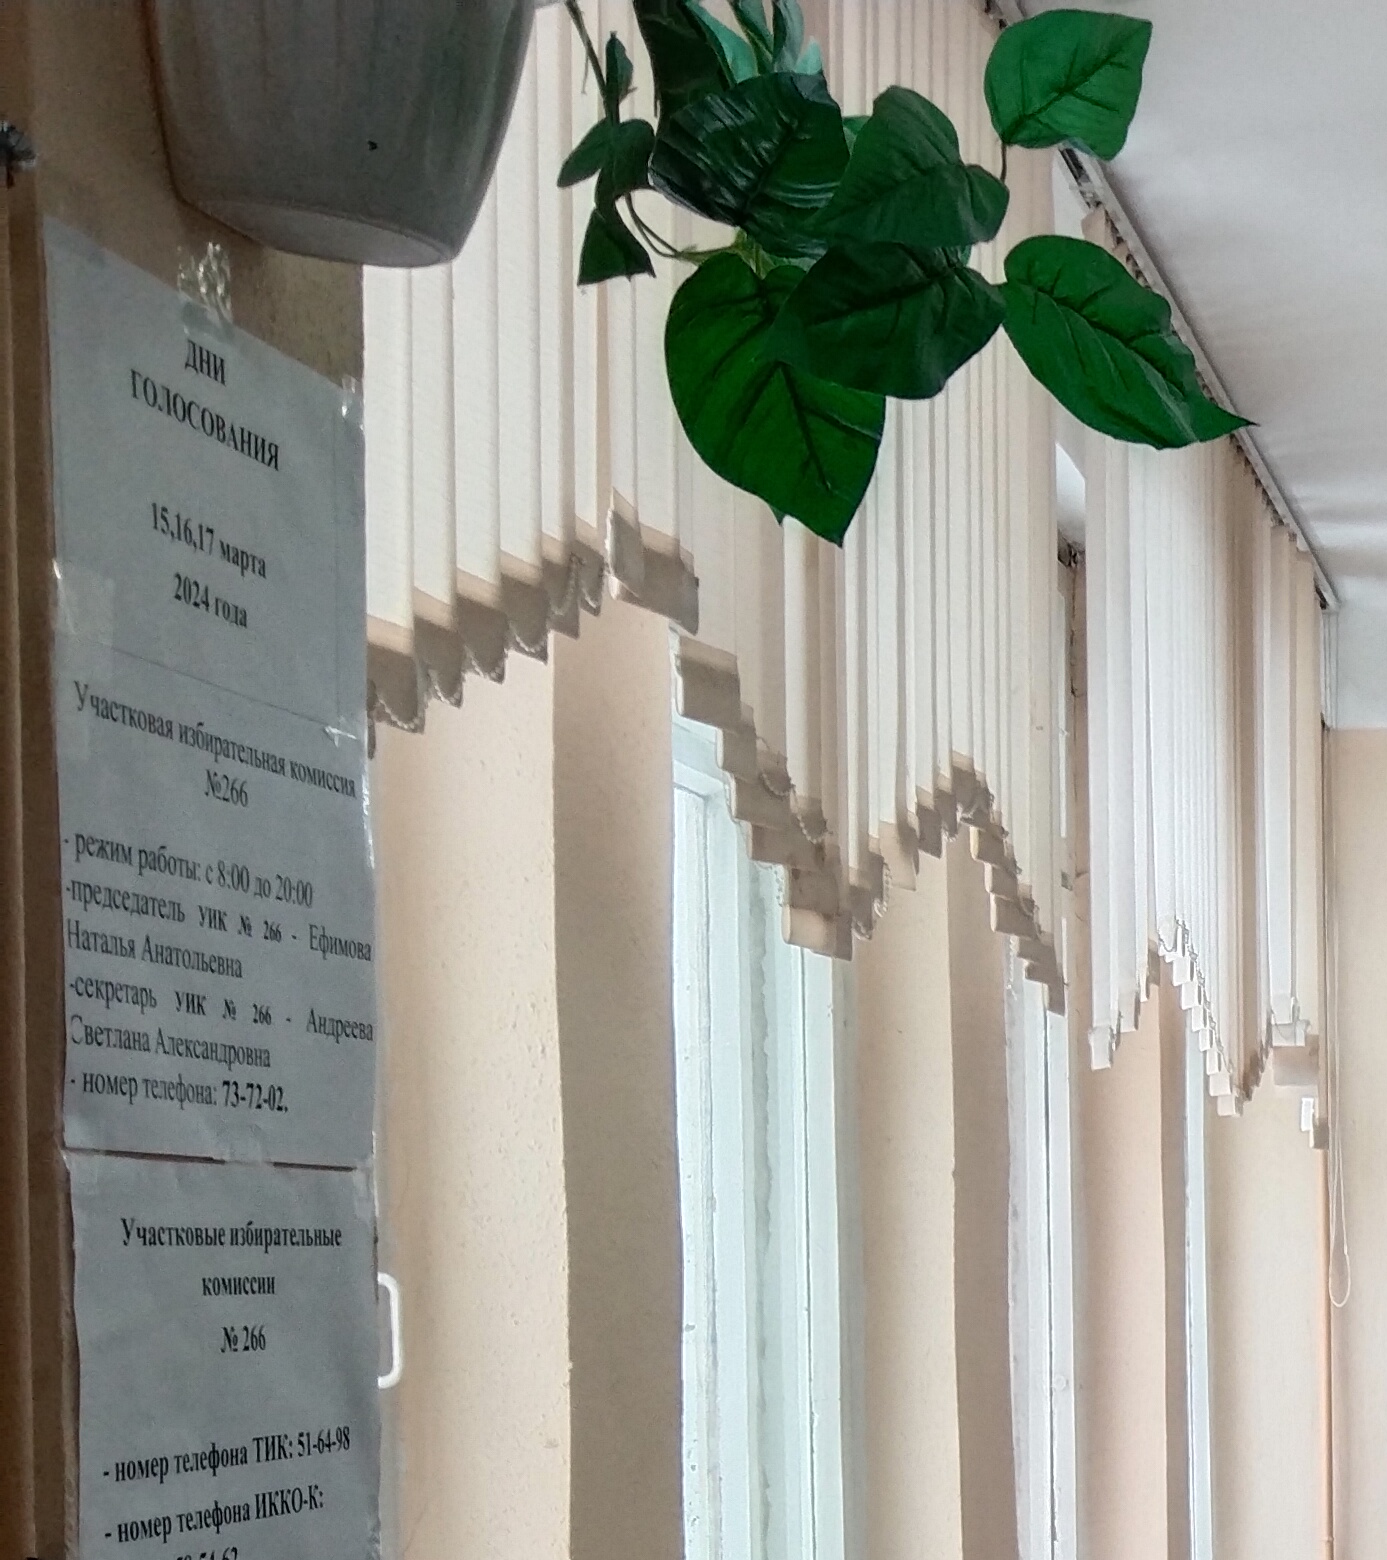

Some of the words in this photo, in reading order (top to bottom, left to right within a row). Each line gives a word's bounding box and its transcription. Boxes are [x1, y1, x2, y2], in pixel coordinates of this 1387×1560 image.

[184, 340, 226, 386] ДНИ
[130, 369, 280, 471] ГОЛОСОВАНИЯ
[151, 502, 215, 554] 15,16,17
[219, 540, 267, 580] марта
[173, 573, 211, 613] 2024
[213, 602, 249, 629] года
[73, 680, 174, 741] Участковая
[178, 722, 286, 776] избирательная
[289, 760, 357, 799] комиссия
[74, 832, 133, 868] режим
[138, 846, 202, 882] работы:
[205, 868, 214, 885] с
[216, 860, 251, 896] 8:00
[253, 877, 273, 900] до
[275, 873, 314, 909] 20:00
[67, 918, 136, 961] Наталья
[141, 934, 243, 980] Анатольевна
[197, 905, 227, 933] УИК
[237, 914, 252, 938] №
[263, 919, 282, 943] 266
[308, 923, 372, 962] Ефимова
[70, 1014, 151, 1051] Светлана
[154, 1027, 271, 1071] Александровна
[174, 990, 207, 1017] УИК
[222, 998, 237, 1021] №
[252, 1003, 272, 1026] 266
[305, 1007, 374, 1045] Андреева
[82, 1071, 139, 1105] номер
[141, 1072, 218, 1110] телефона:
[120, 1217, 226, 1247] Участковые
[229, 1220, 343, 1254] избирательные
[202, 1276, 276, 1297] комиссии
[220, 1325, 239, 1353] №
[242, 1324, 267, 1352] 266
[114, 1455, 169, 1485] номер
[174, 1442, 248, 1477] телефона
[252, 1433, 295, 1464] ТИК:
[297, 1425, 351, 1457] 51-64-98
[117, 1515, 172, 1544] номер
[176, 1500, 251, 1535] телефона
[254, 1484, 325, 1521] ИККО-К:
